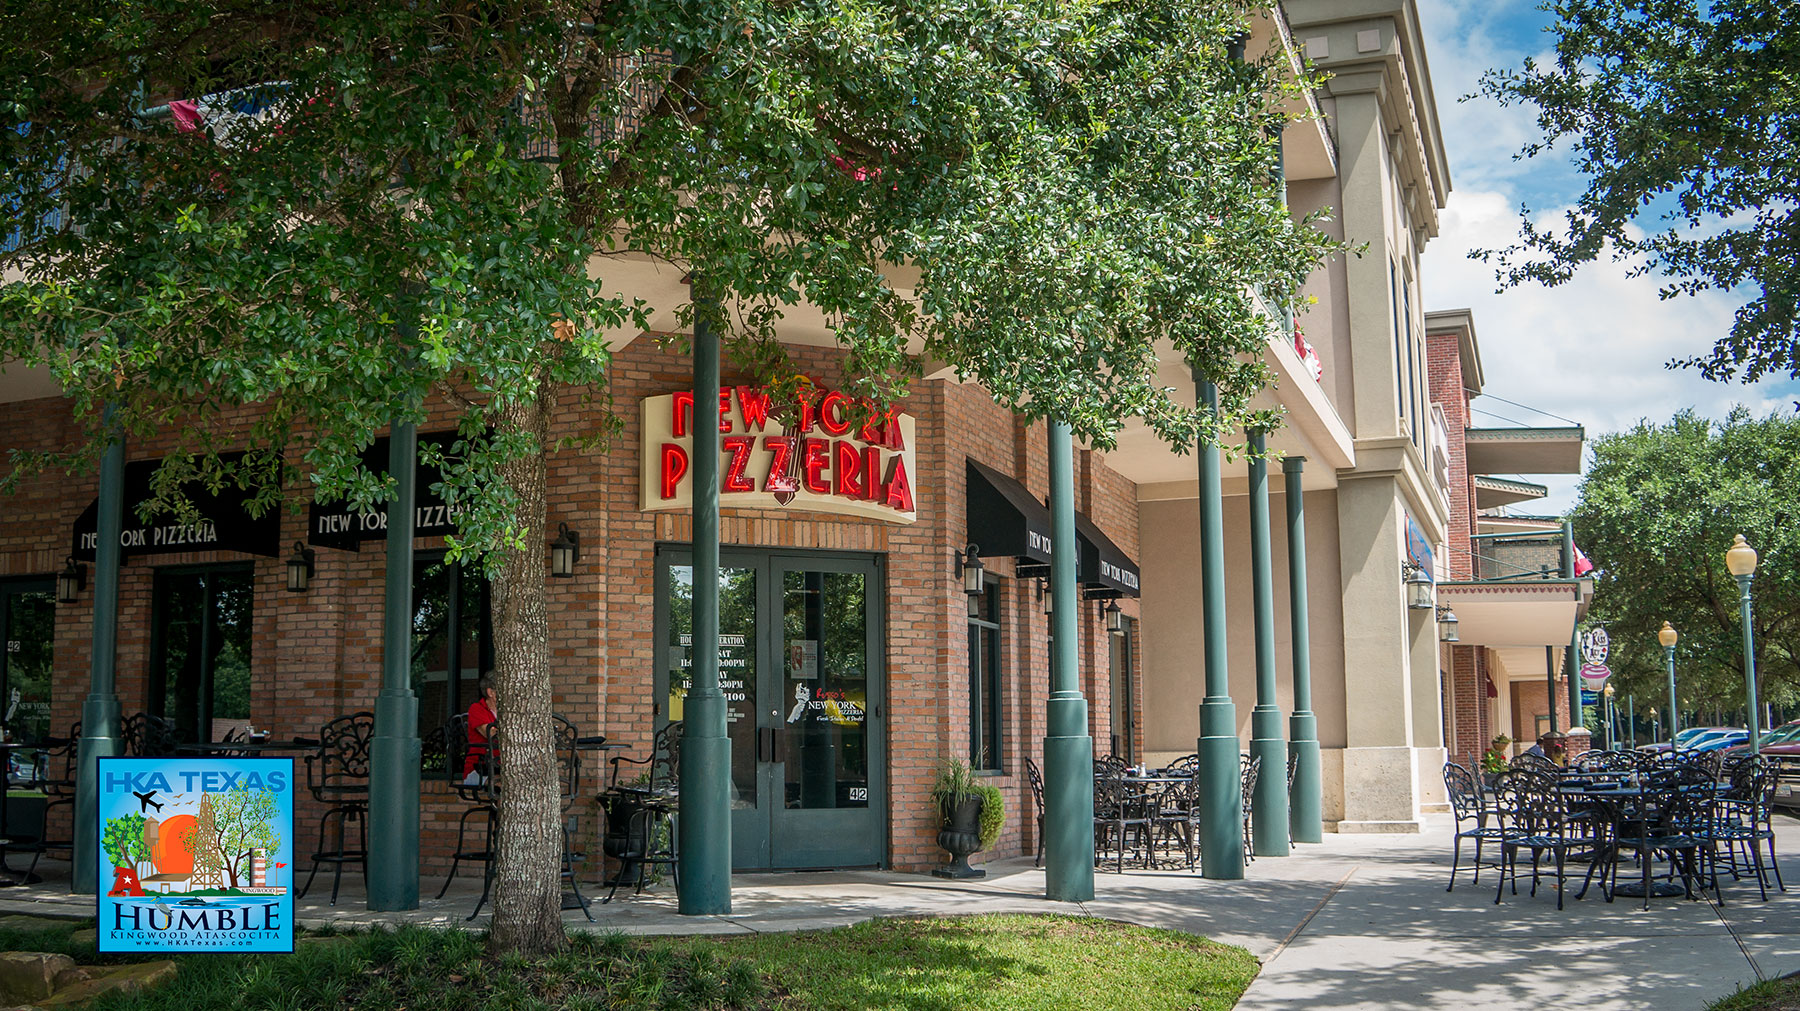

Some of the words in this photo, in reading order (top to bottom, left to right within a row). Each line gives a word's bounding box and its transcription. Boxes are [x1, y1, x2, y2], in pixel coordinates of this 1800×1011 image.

[661, 435, 915, 513] PZZERIA
[319, 513, 352, 533] NEW
[358, 511, 387, 531] YOR
[81, 532, 97, 549] NE
[120, 529, 146, 547] ORK
[1029, 530, 1041, 550] NEW
[1101, 560, 1110, 577] NEW
[719, 636, 745, 645] ERATION
[816, 687, 845, 699] Russo's
[808, 701, 828, 710] NEW
[831, 701, 857, 710] YORK
[850, 788, 867, 799] 42
